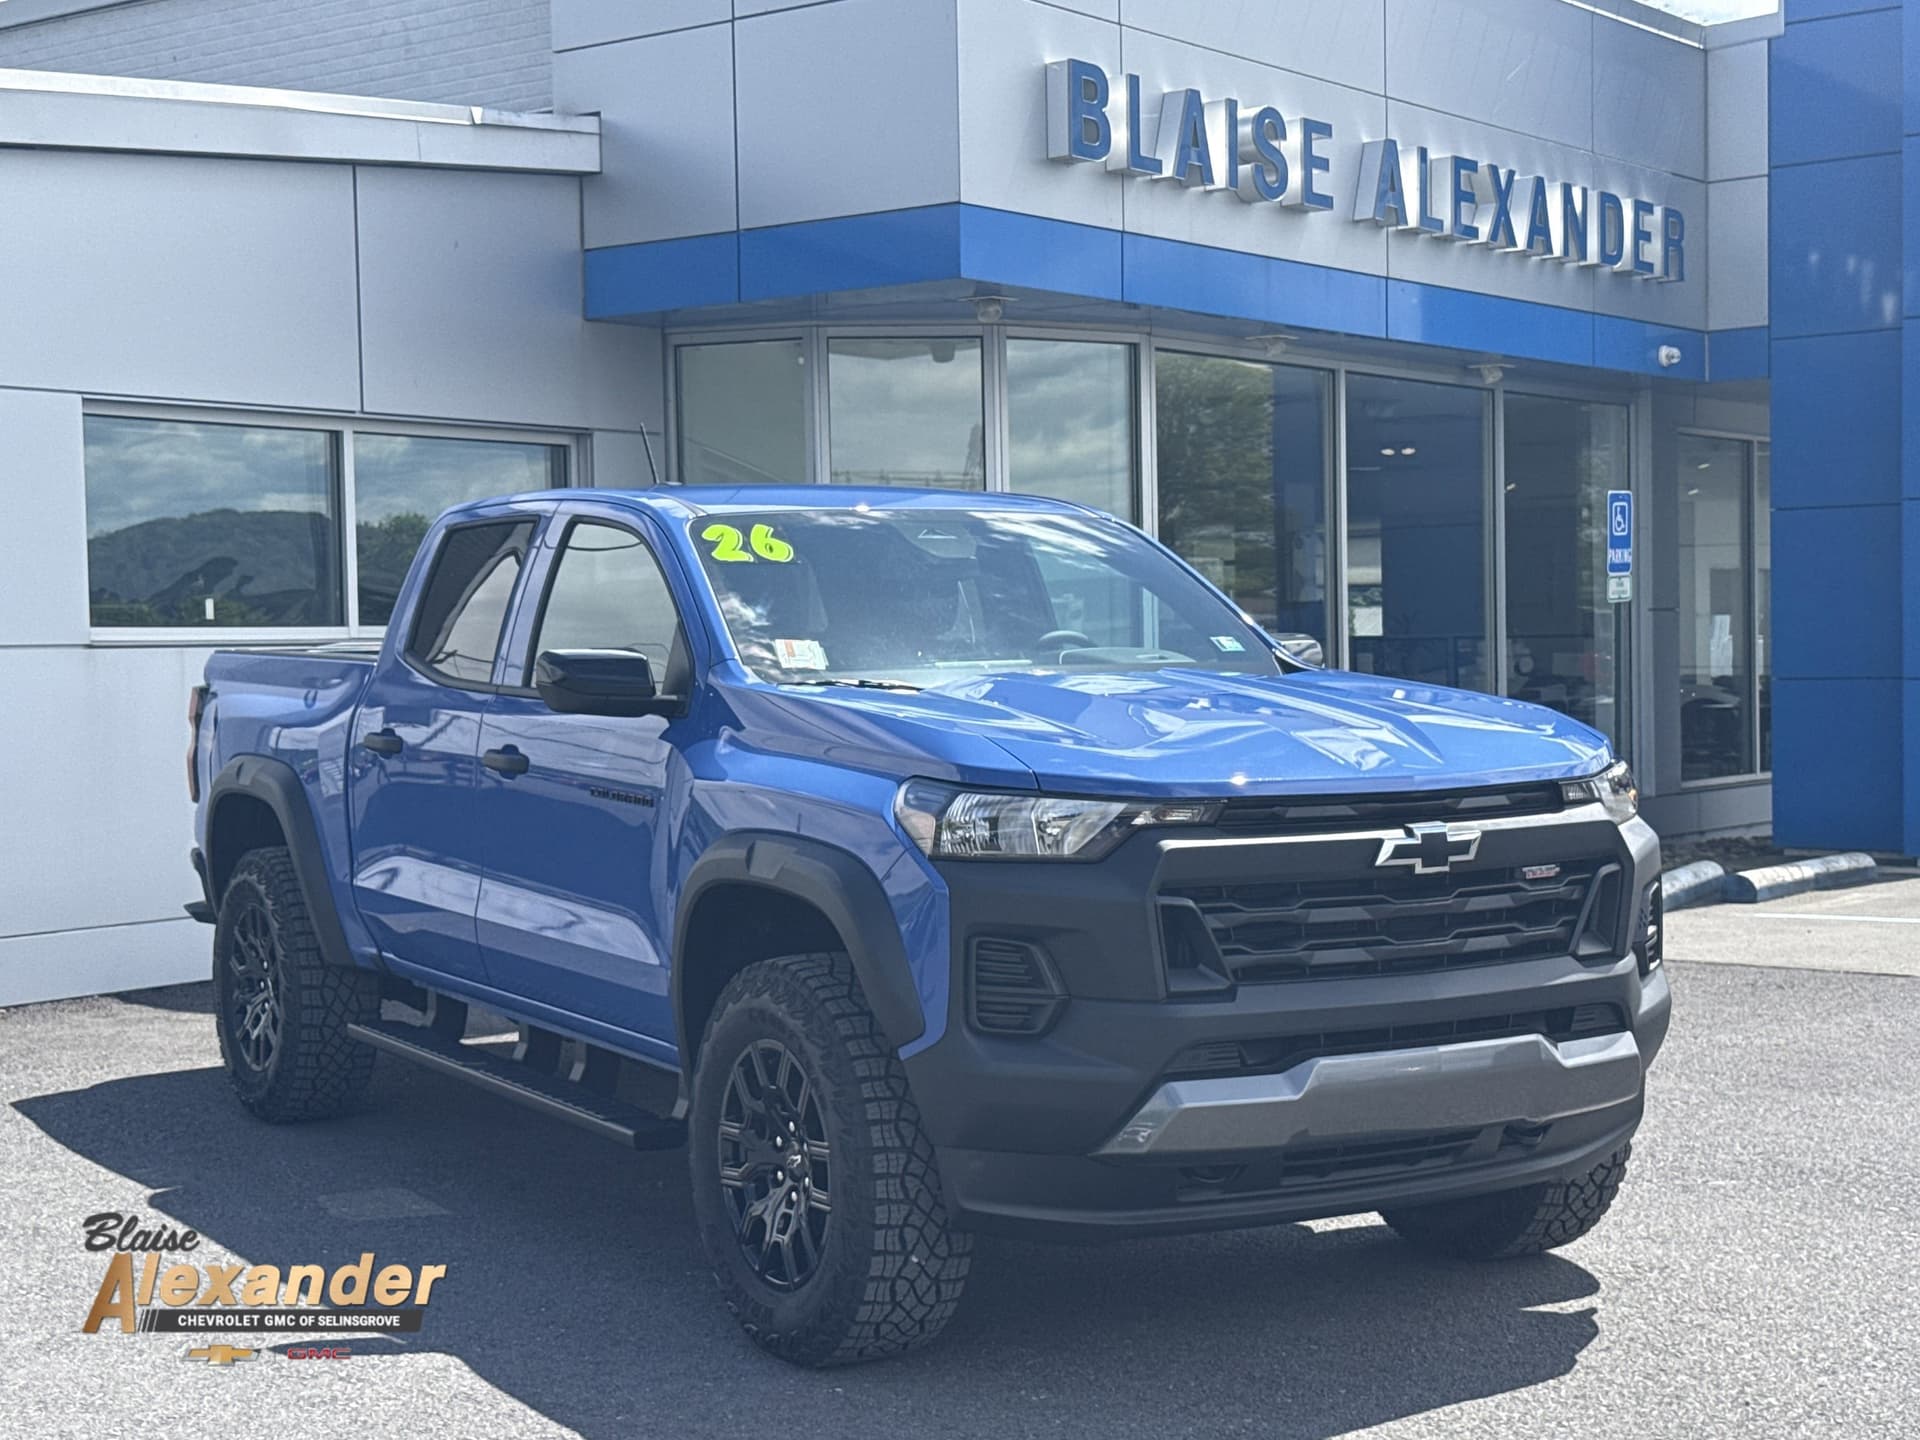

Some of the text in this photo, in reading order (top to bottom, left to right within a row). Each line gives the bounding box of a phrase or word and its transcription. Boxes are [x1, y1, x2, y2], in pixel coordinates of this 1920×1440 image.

[1060, 58, 1685, 282] BLAISE ALEXANDER
[701, 523, 794, 562] 26
